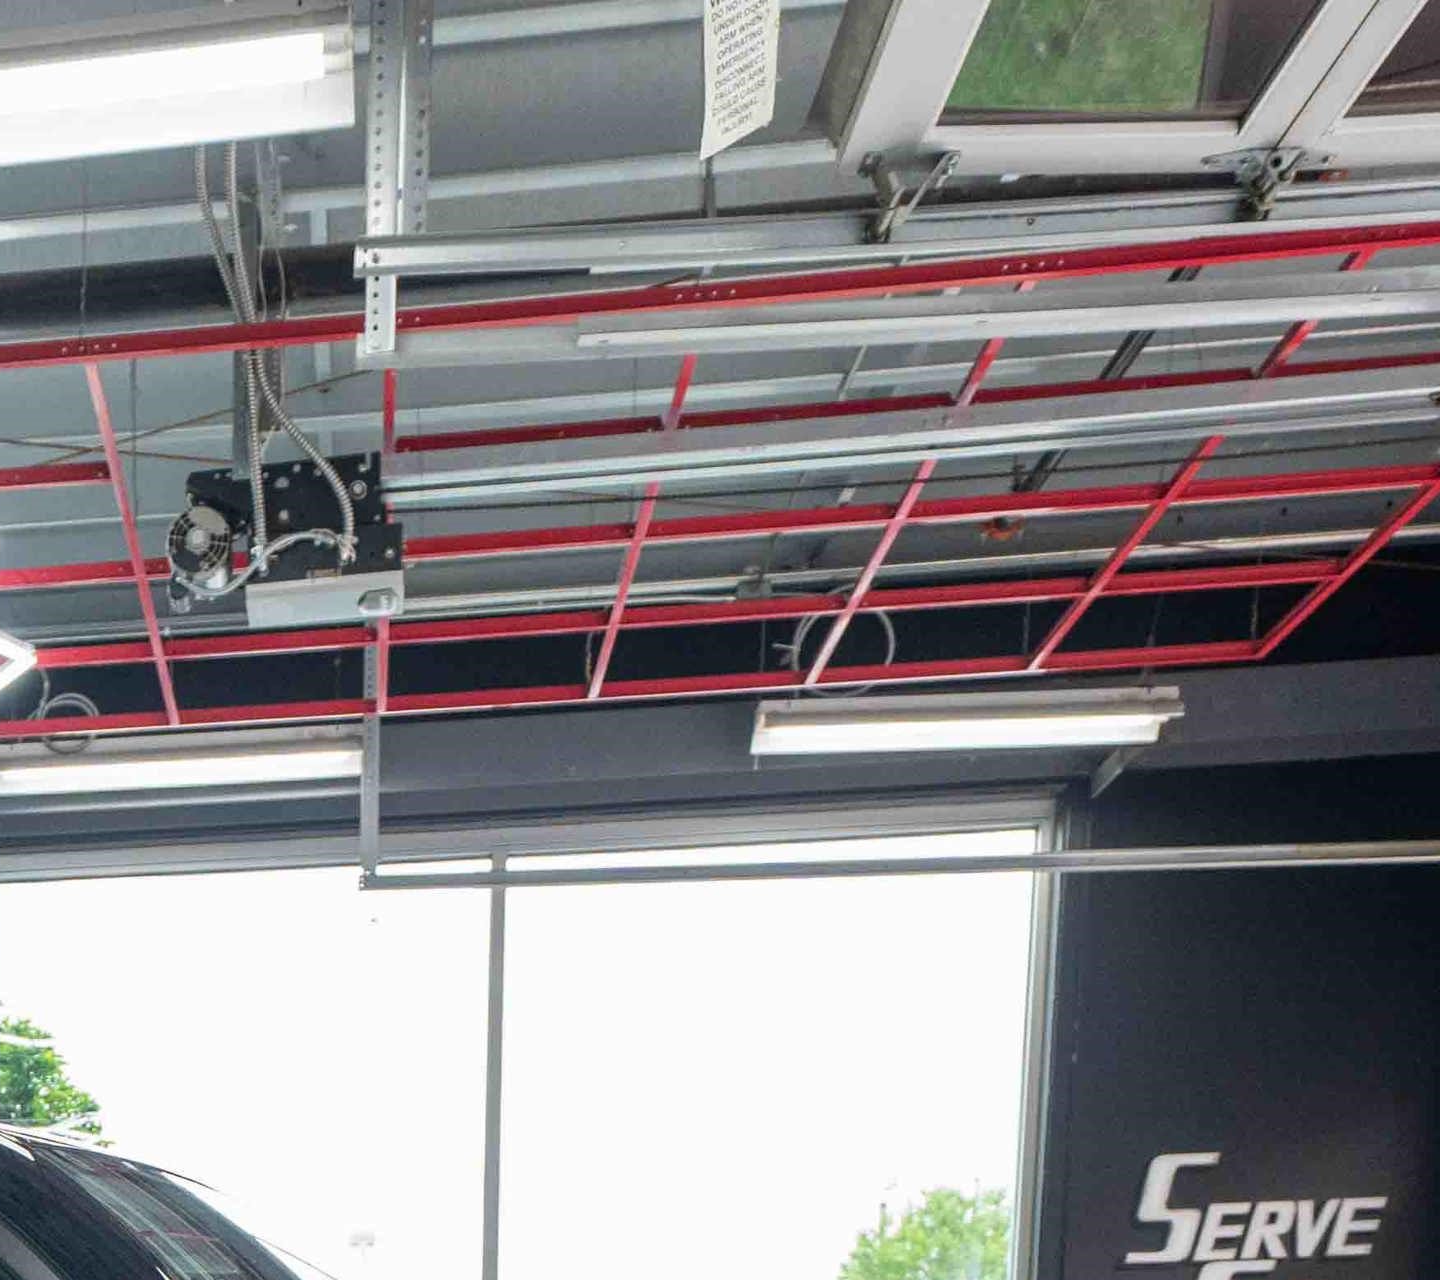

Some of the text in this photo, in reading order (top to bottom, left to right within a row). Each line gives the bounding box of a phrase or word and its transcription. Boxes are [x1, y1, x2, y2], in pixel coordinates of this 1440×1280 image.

[714, 13, 742, 34] UNDER
[717, 27, 763, 60] OPERATING
[718, 29, 737, 46] ARM
[1125, 1152, 1388, 1264] SERVE
